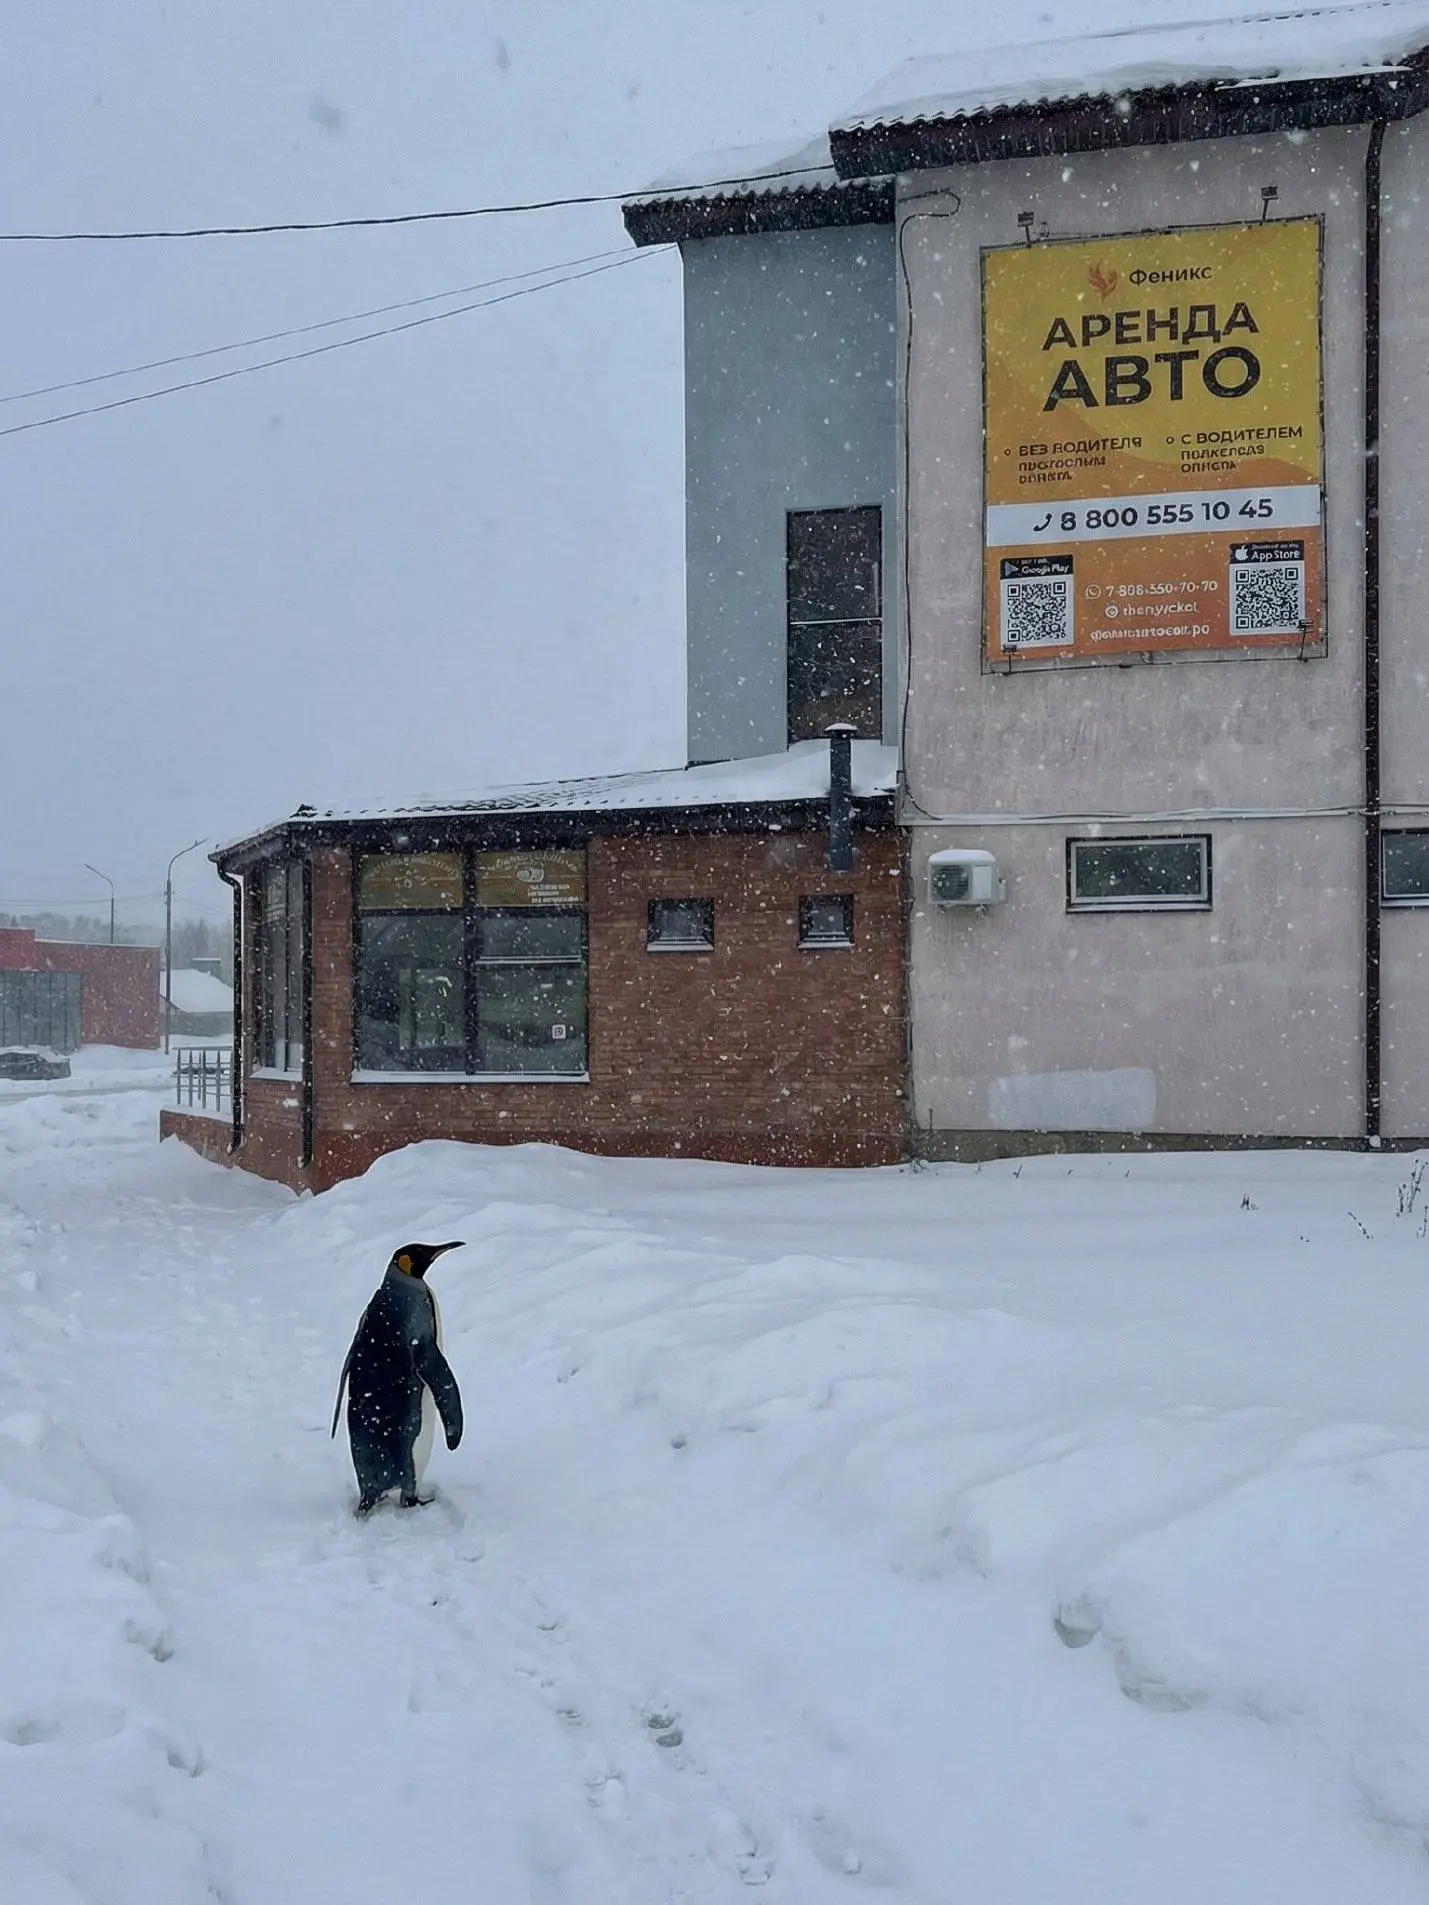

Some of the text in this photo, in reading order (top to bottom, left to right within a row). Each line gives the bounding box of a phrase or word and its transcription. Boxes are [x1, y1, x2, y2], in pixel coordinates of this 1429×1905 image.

[1129, 266, 1213, 287] Феникс
[1042, 302, 1259, 351] АРЕНДА
[1042, 346, 1261, 412] АВТО
[1181, 426, 1303, 445] С ВОДИТЕЛЕМ
[1019, 443, 1048, 457] БЕЗ
[1060, 498, 1274, 531] 8 800 555 10 45
[1251, 550, 1301, 562] App Store
